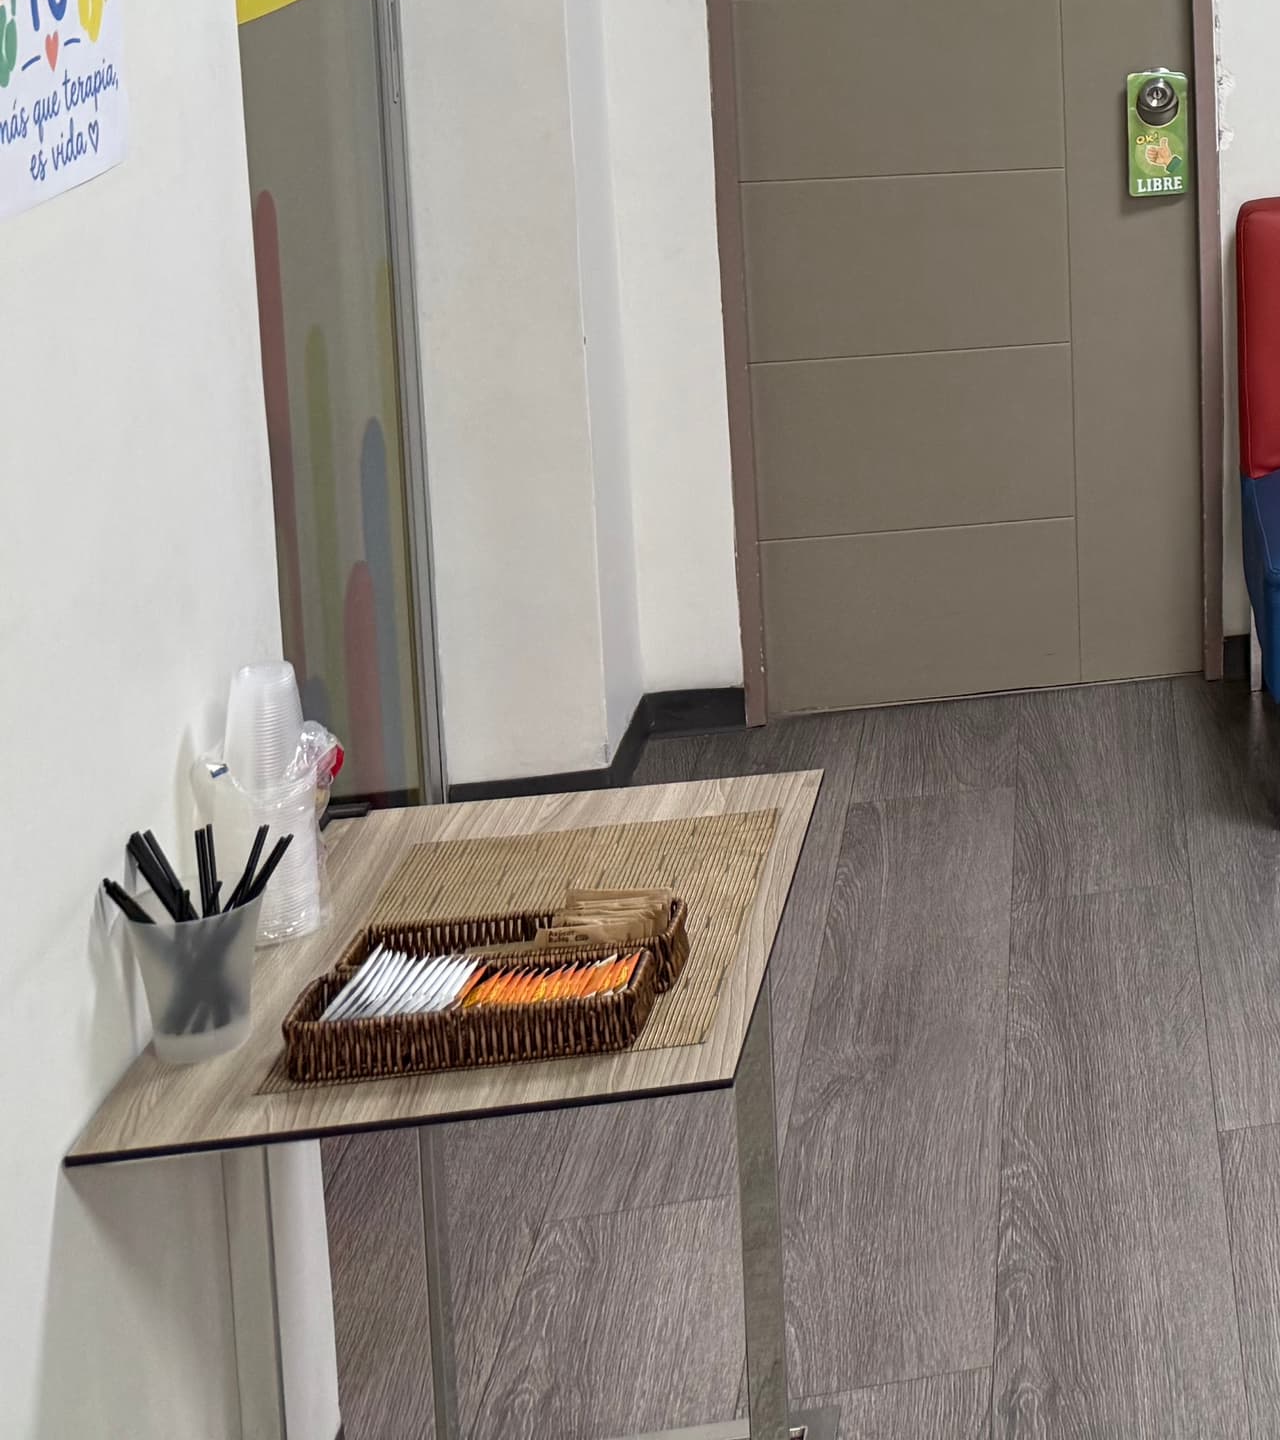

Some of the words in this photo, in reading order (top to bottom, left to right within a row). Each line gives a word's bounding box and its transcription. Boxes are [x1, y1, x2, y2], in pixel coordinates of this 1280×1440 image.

[33, 90, 61, 144] que
[63, 57, 119, 112] terapia,
[30, 152, 48, 181] es
[52, 117, 87, 171] vida
[1137, 176, 1183, 193] LIBRE
